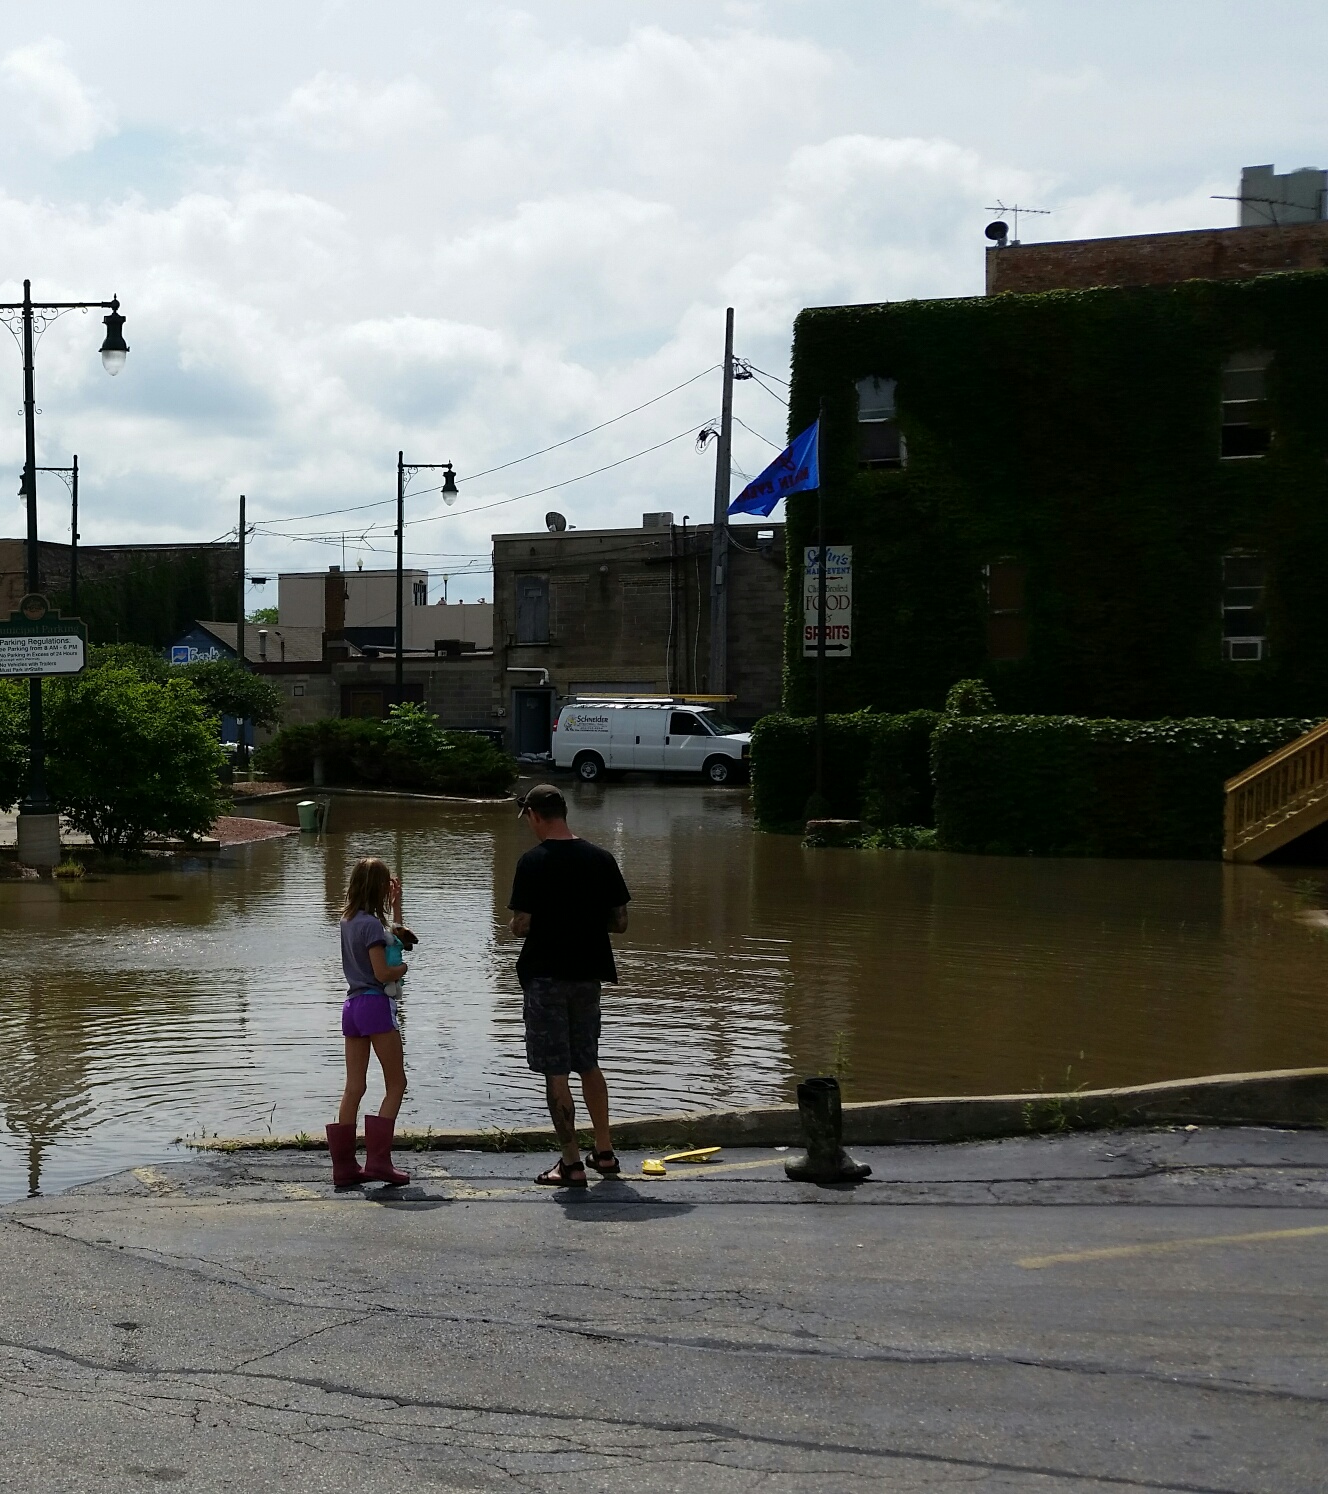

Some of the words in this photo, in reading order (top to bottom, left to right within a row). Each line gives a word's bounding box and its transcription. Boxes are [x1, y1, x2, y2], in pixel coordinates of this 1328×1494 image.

[806, 595, 850, 610] FOOD
[42, 624, 80, 634] Parking
[805, 625, 849, 640] SPRITS
